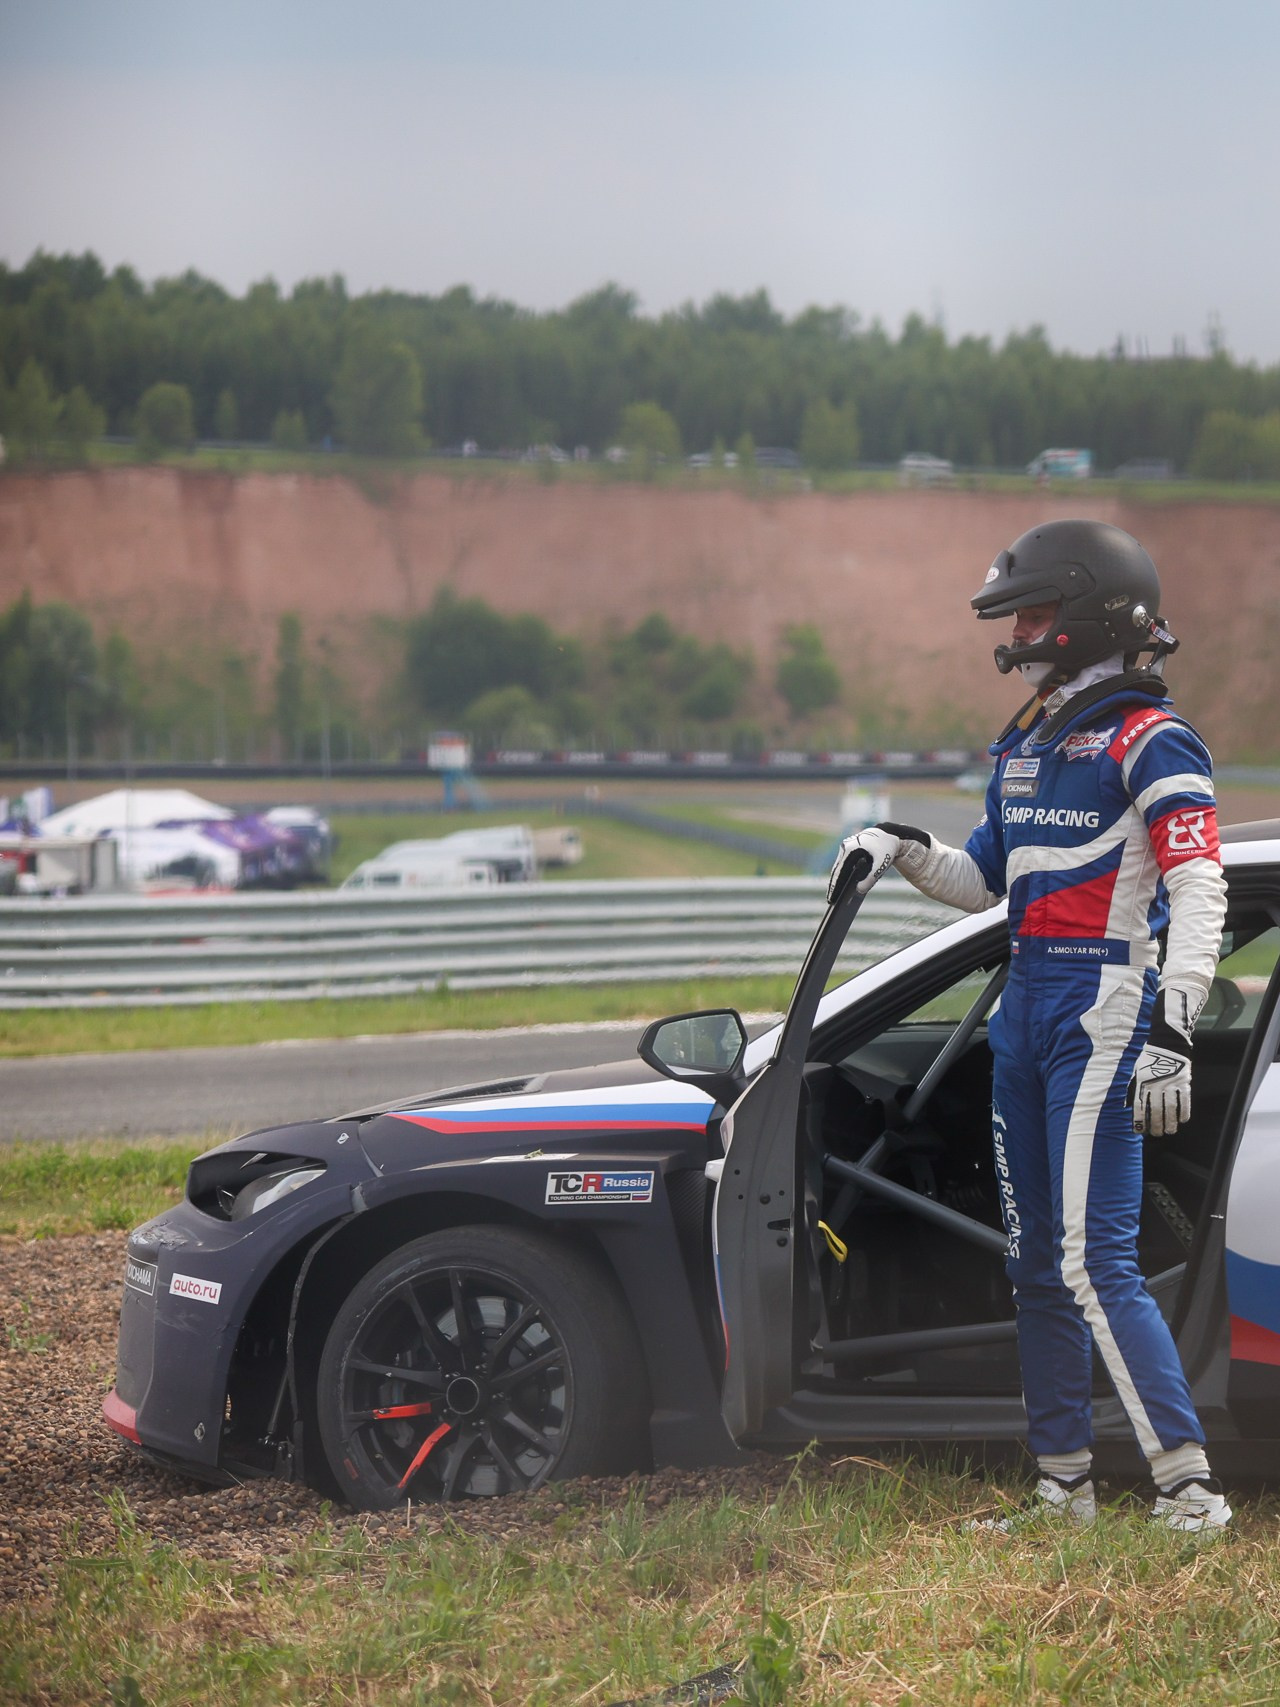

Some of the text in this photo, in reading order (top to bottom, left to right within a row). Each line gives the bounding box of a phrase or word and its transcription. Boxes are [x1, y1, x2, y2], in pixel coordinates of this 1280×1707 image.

[1005, 807, 1100, 828] SMP RACING
[1047, 946, 1087, 955] A.SMOLYAR
[550, 1174, 649, 1193] TCR Russia
[993, 1129, 1022, 1260] SMP RACING
[173, 1279, 218, 1299] auto.ru
